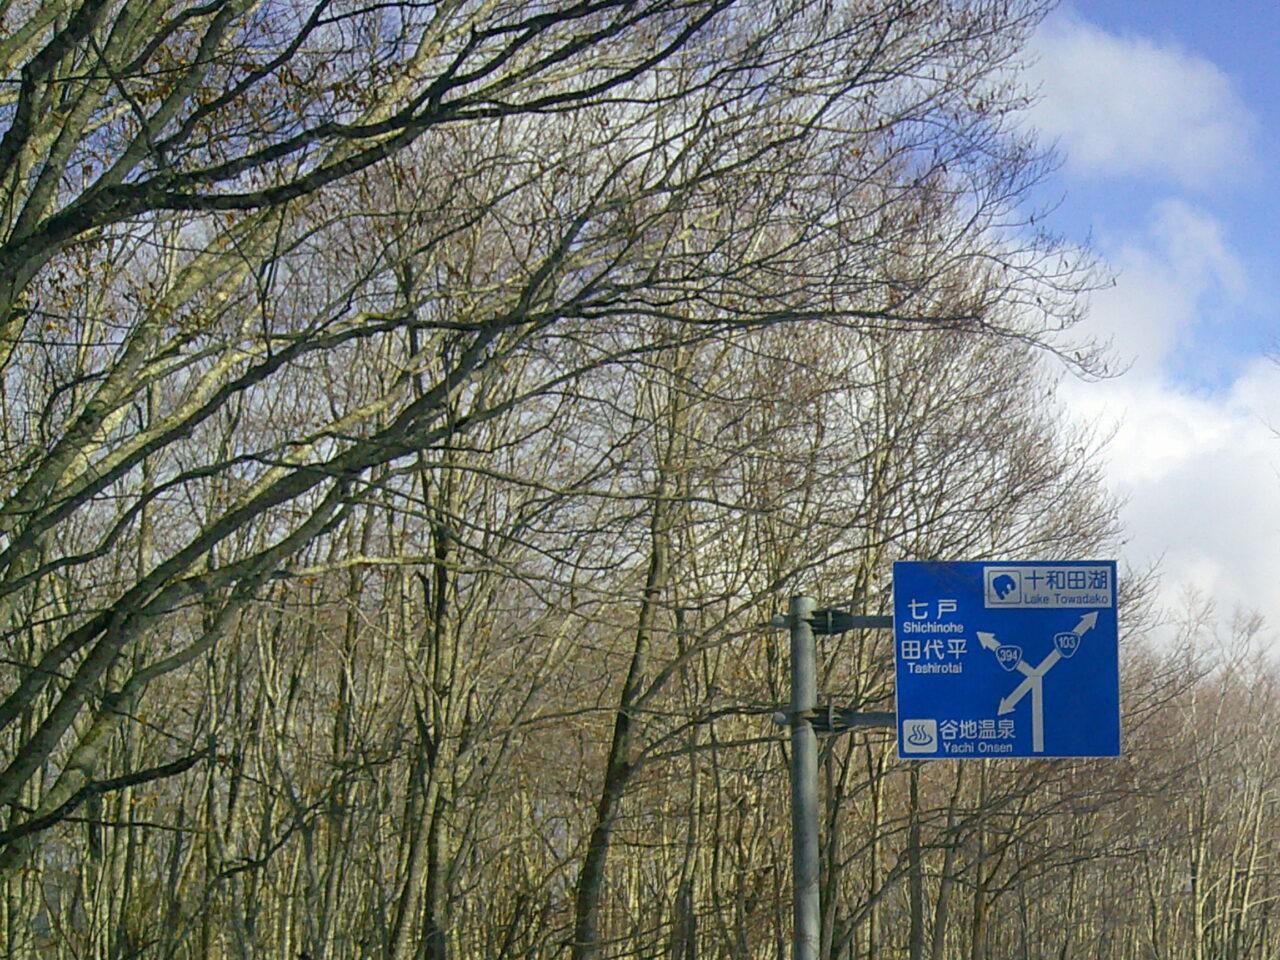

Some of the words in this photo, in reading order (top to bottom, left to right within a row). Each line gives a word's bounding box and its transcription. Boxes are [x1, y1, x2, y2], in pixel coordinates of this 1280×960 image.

[1025, 570, 1108, 589] 十和田湖
[1024, 594, 1049, 604] Lake
[1054, 593, 1109, 604] Towadako
[908, 599, 957, 620] 七戸
[903, 622, 964, 633] Shichinohe
[1059, 636, 1075, 648] 103
[901, 639, 967, 660] 田代平
[999, 649, 1018, 661] 394
[908, 662, 962, 673] Tashirotai
[939, 720, 1016, 739] 谷地温泉
[944, 742, 975, 753] Yachi
[978, 743, 1012, 752] Onsen
